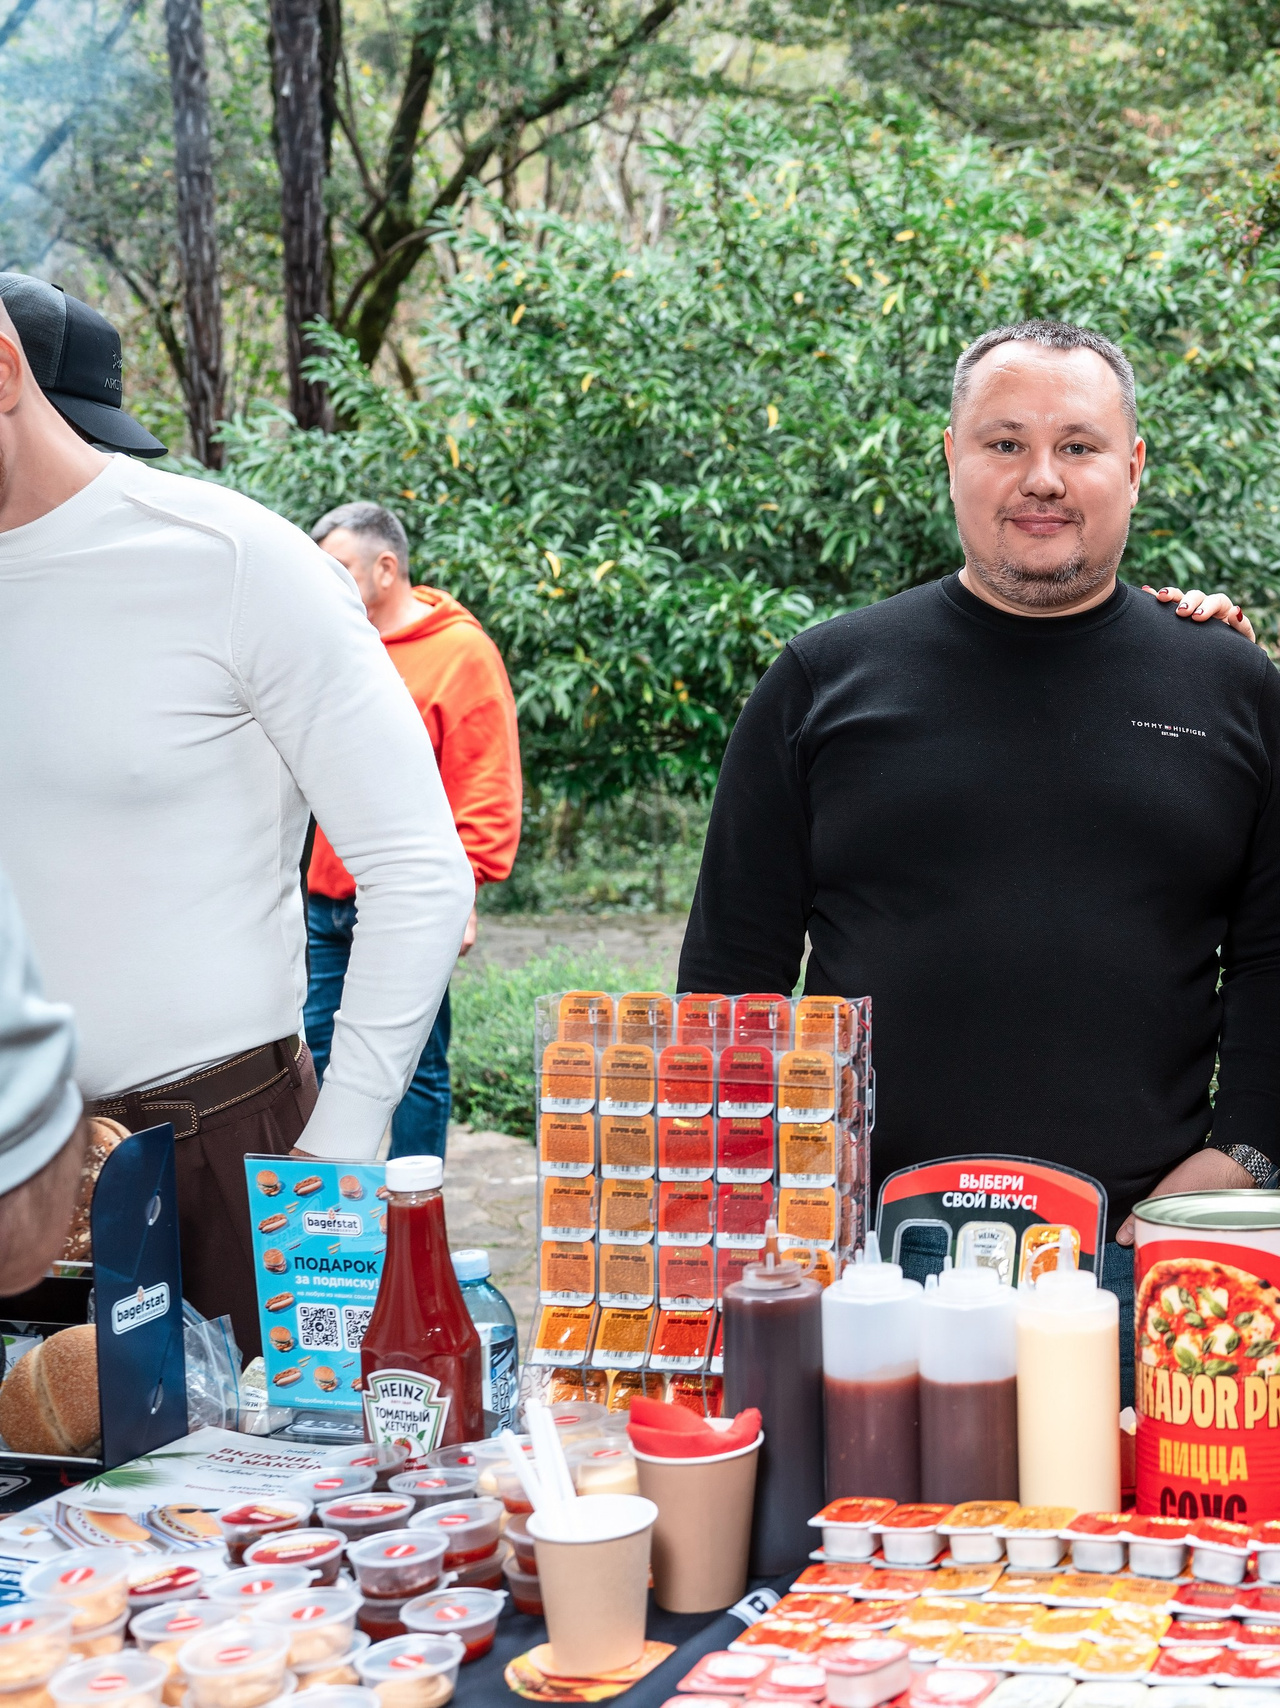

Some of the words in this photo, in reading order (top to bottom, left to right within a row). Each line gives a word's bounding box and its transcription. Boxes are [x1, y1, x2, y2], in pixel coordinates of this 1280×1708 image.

[1131, 720, 1163, 730] TOMMY
[1173, 725, 1206, 737] HILFIGER
[959, 1173, 1024, 1191] ВЫБЕРИ
[942, 1190, 987, 1209] СВОЙ
[990, 1193, 1038, 1211] ВКУС!
[307, 1216, 358, 1229] bagerstat
[978, 1232, 1000, 1241] HEINZ
[294, 1256, 378, 1275] ПОДАРОК
[295, 1275, 310, 1285] за
[312, 1275, 380, 1291] подписку!
[117, 1292, 165, 1322] bagerstat
[379, 1382, 425, 1402] HEINZ
[374, 1406, 431, 1423] ТОМАТНЫЙ
[385, 1420, 419, 1433] КЕТЧУП
[206, 1453, 235, 1463] НА
[218, 1448, 311, 1463] ВКЛЮЧИ
[1159, 1437, 1249, 1486] ПИЦЦА
